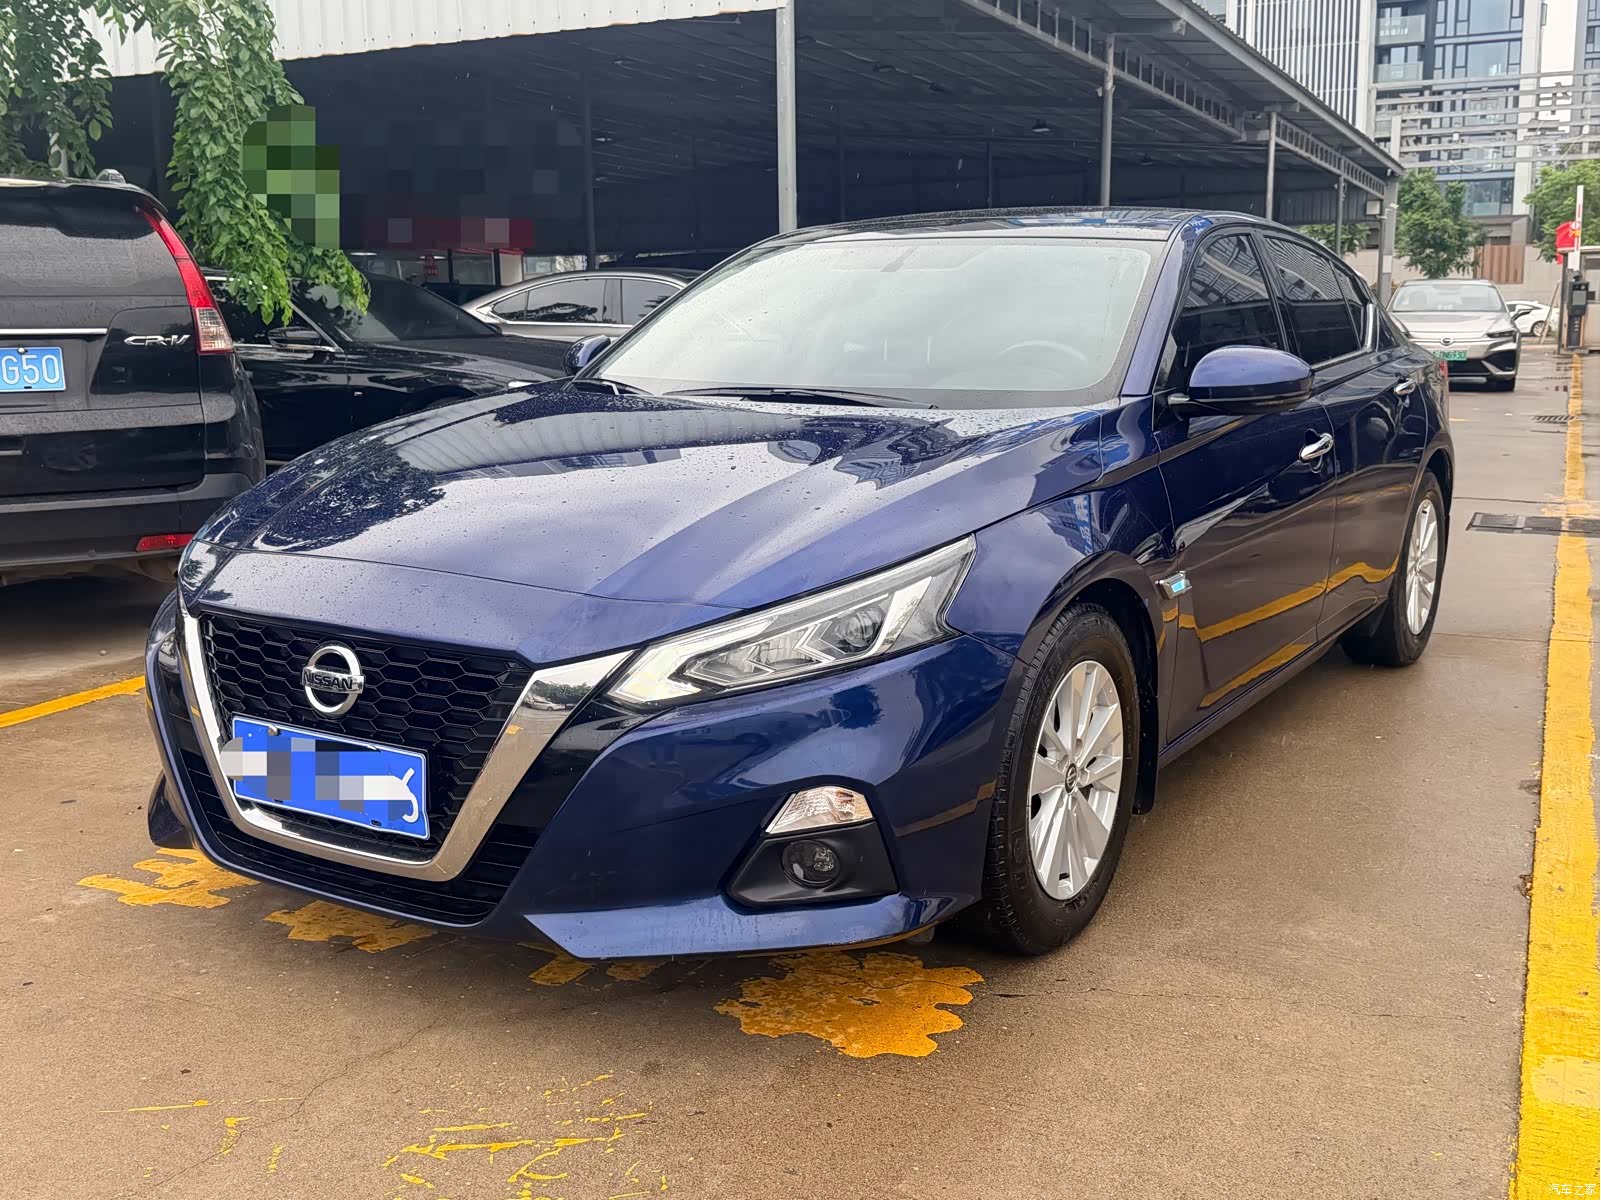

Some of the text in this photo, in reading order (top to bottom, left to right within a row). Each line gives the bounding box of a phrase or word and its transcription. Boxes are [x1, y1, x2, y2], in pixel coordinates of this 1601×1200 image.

[124, 334, 191, 346] CR-V
[1, 354, 61, 385] G50
[303, 671, 353, 690] NISSAN
